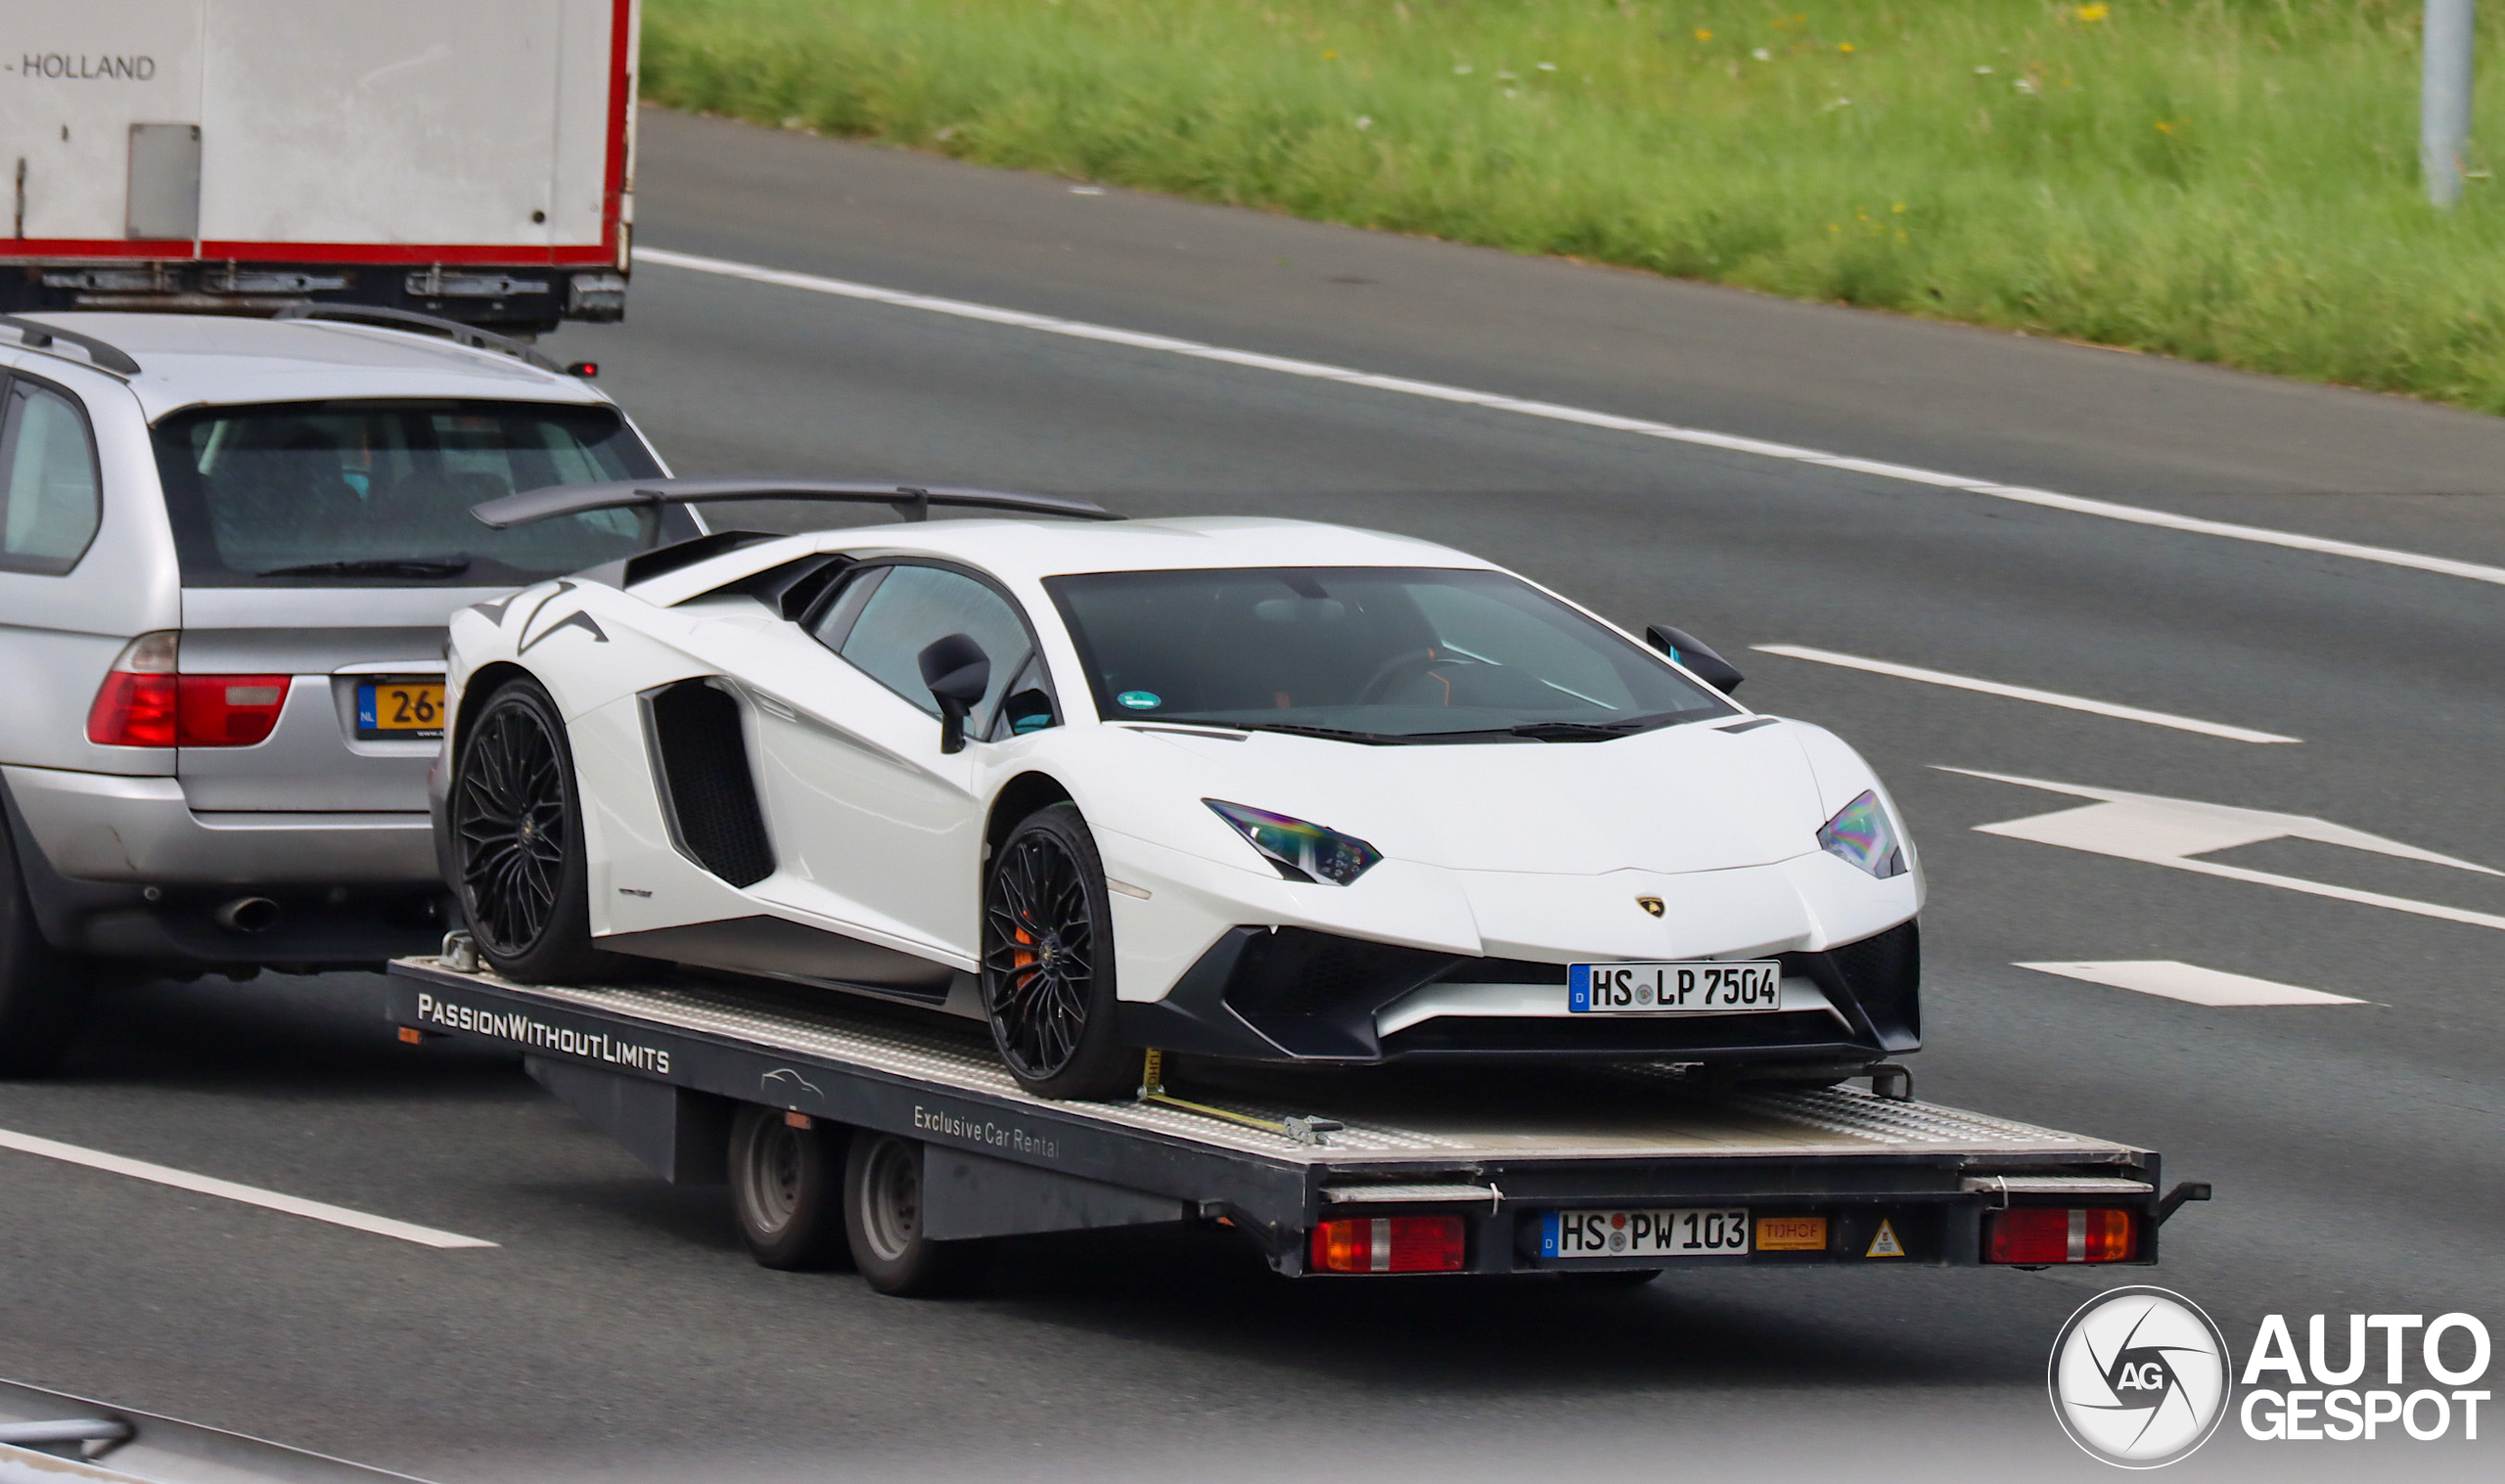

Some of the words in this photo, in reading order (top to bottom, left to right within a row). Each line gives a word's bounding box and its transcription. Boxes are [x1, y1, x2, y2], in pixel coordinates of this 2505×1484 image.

[23, 53, 155, 80] HOLLAND
[360, 712, 375, 723] NL
[1592, 969, 1632, 1006] HS
[1657, 969, 1695, 1006] LP
[1704, 967, 1776, 1005] 7504
[1575, 992, 1584, 1004] D
[914, 1105, 981, 1142] Exclusive
[984, 1122, 1010, 1147] Car
[1013, 1129, 1060, 1159] Rental
[1562, 1214, 1606, 1250] HS
[1630, 1213, 1675, 1250] PW
[1682, 1212, 1746, 1249] 103
[1765, 1223, 1818, 1237] TIJHOF
[1545, 1238, 1553, 1249] D
